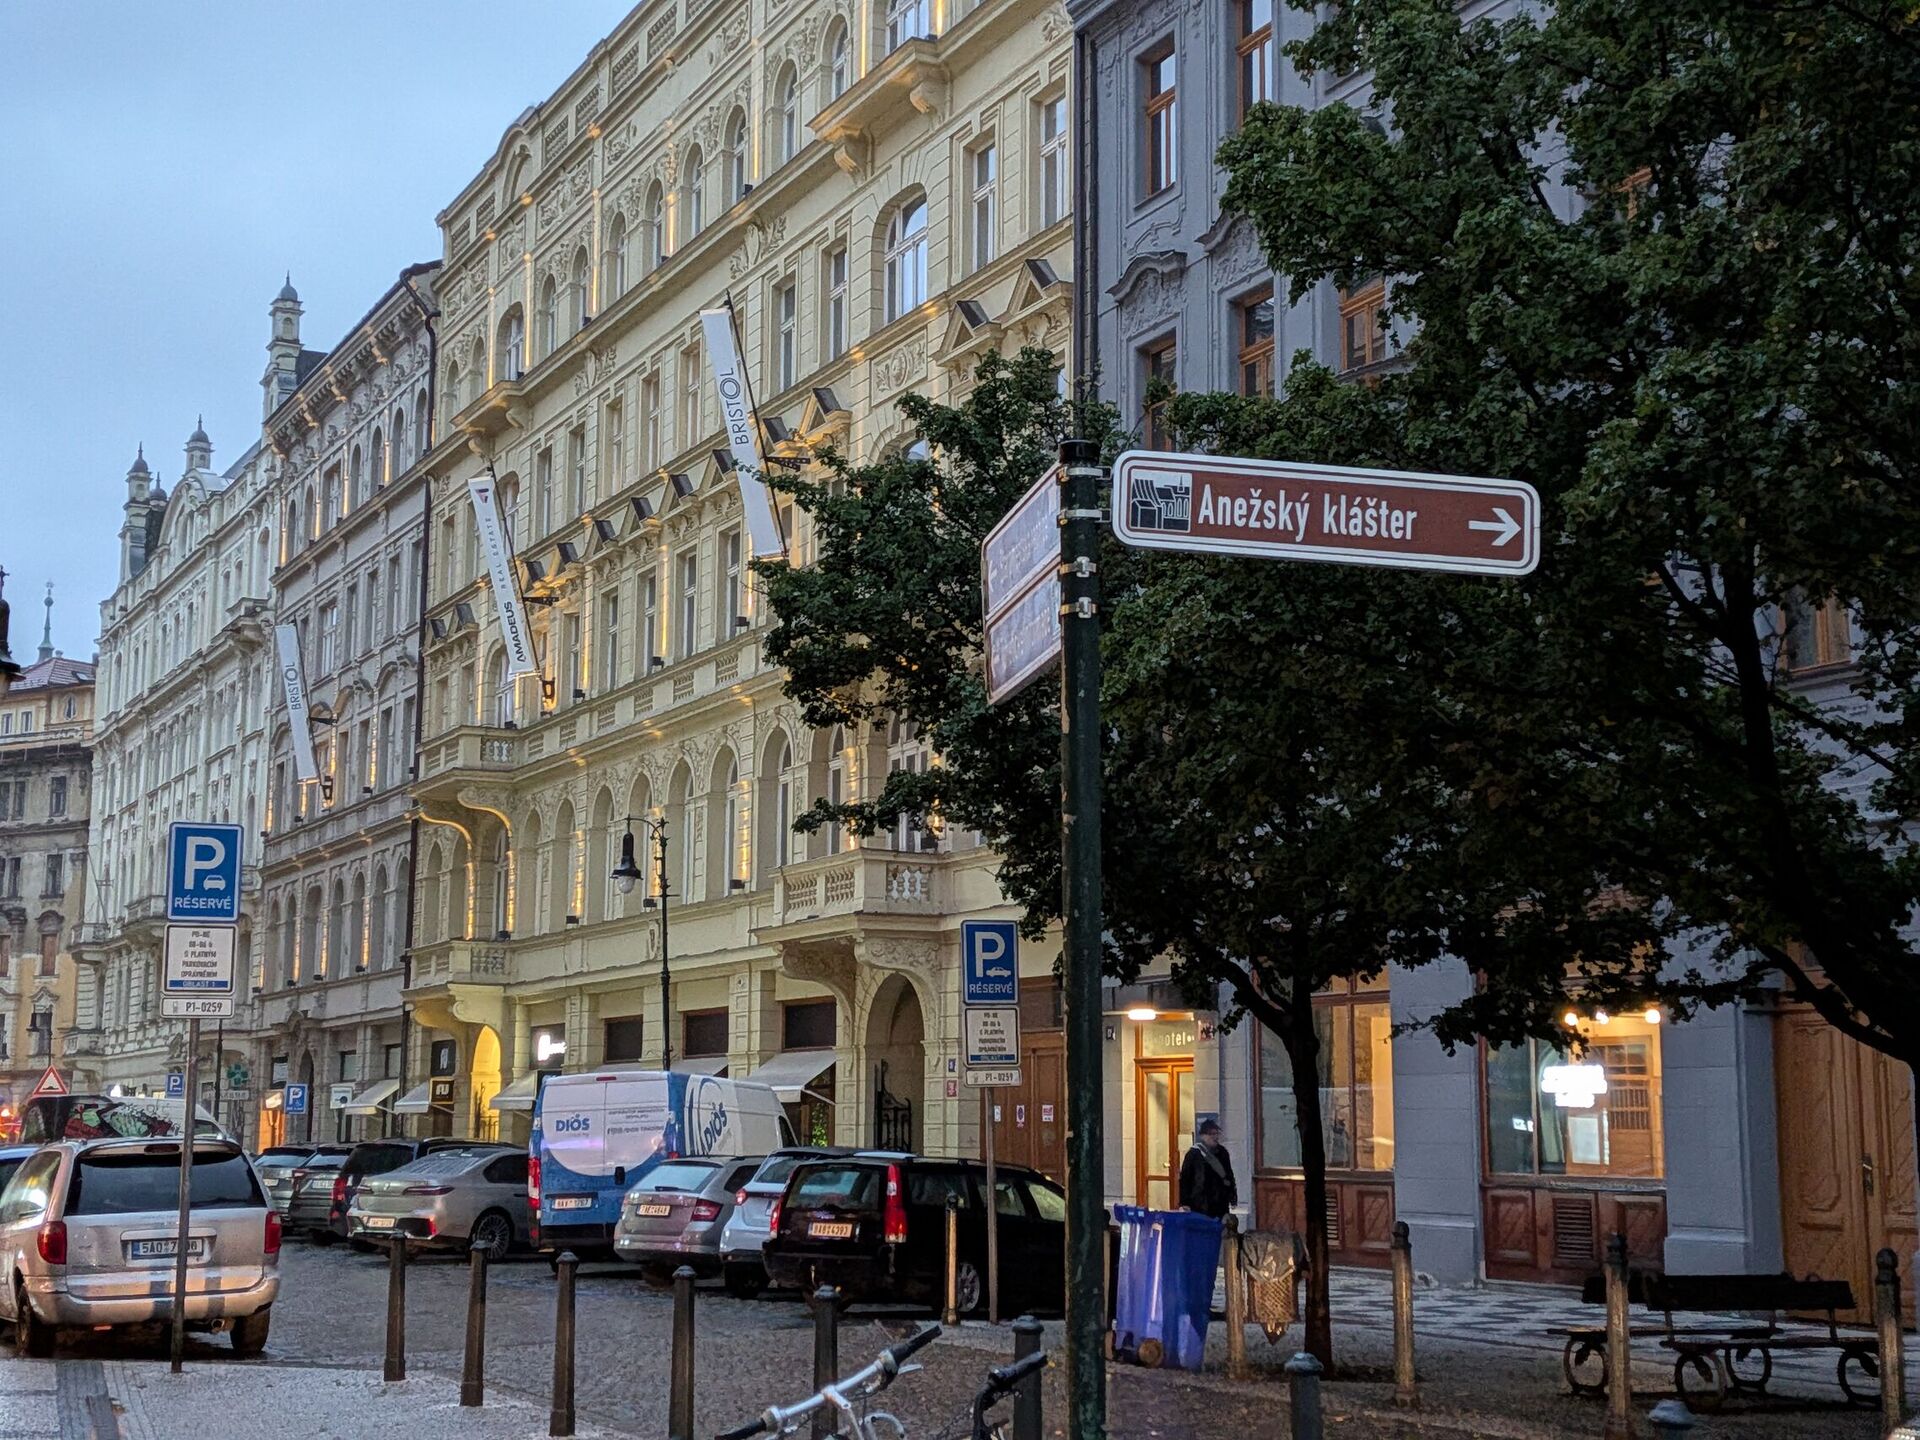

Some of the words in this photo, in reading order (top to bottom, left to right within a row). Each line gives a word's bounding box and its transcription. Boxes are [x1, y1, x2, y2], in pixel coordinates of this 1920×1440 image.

[719, 367, 749, 446] BRISTOL
[485, 517, 499, 557] ESTATE
[1197, 484, 1311, 543] Anežský
[1323, 492, 1418, 541] klášter
[495, 564, 508, 590] REAL
[503, 601, 527, 663] AMADEUS
[284, 662, 302, 711] BRISTOL
[184, 836, 226, 890] P
[174, 894, 232, 910] RÉSERVÉ
[975, 931, 1006, 978] P
[185, 1002, 222, 1013] P1-0259
[969, 981, 1013, 994] RÉSERVÉ
